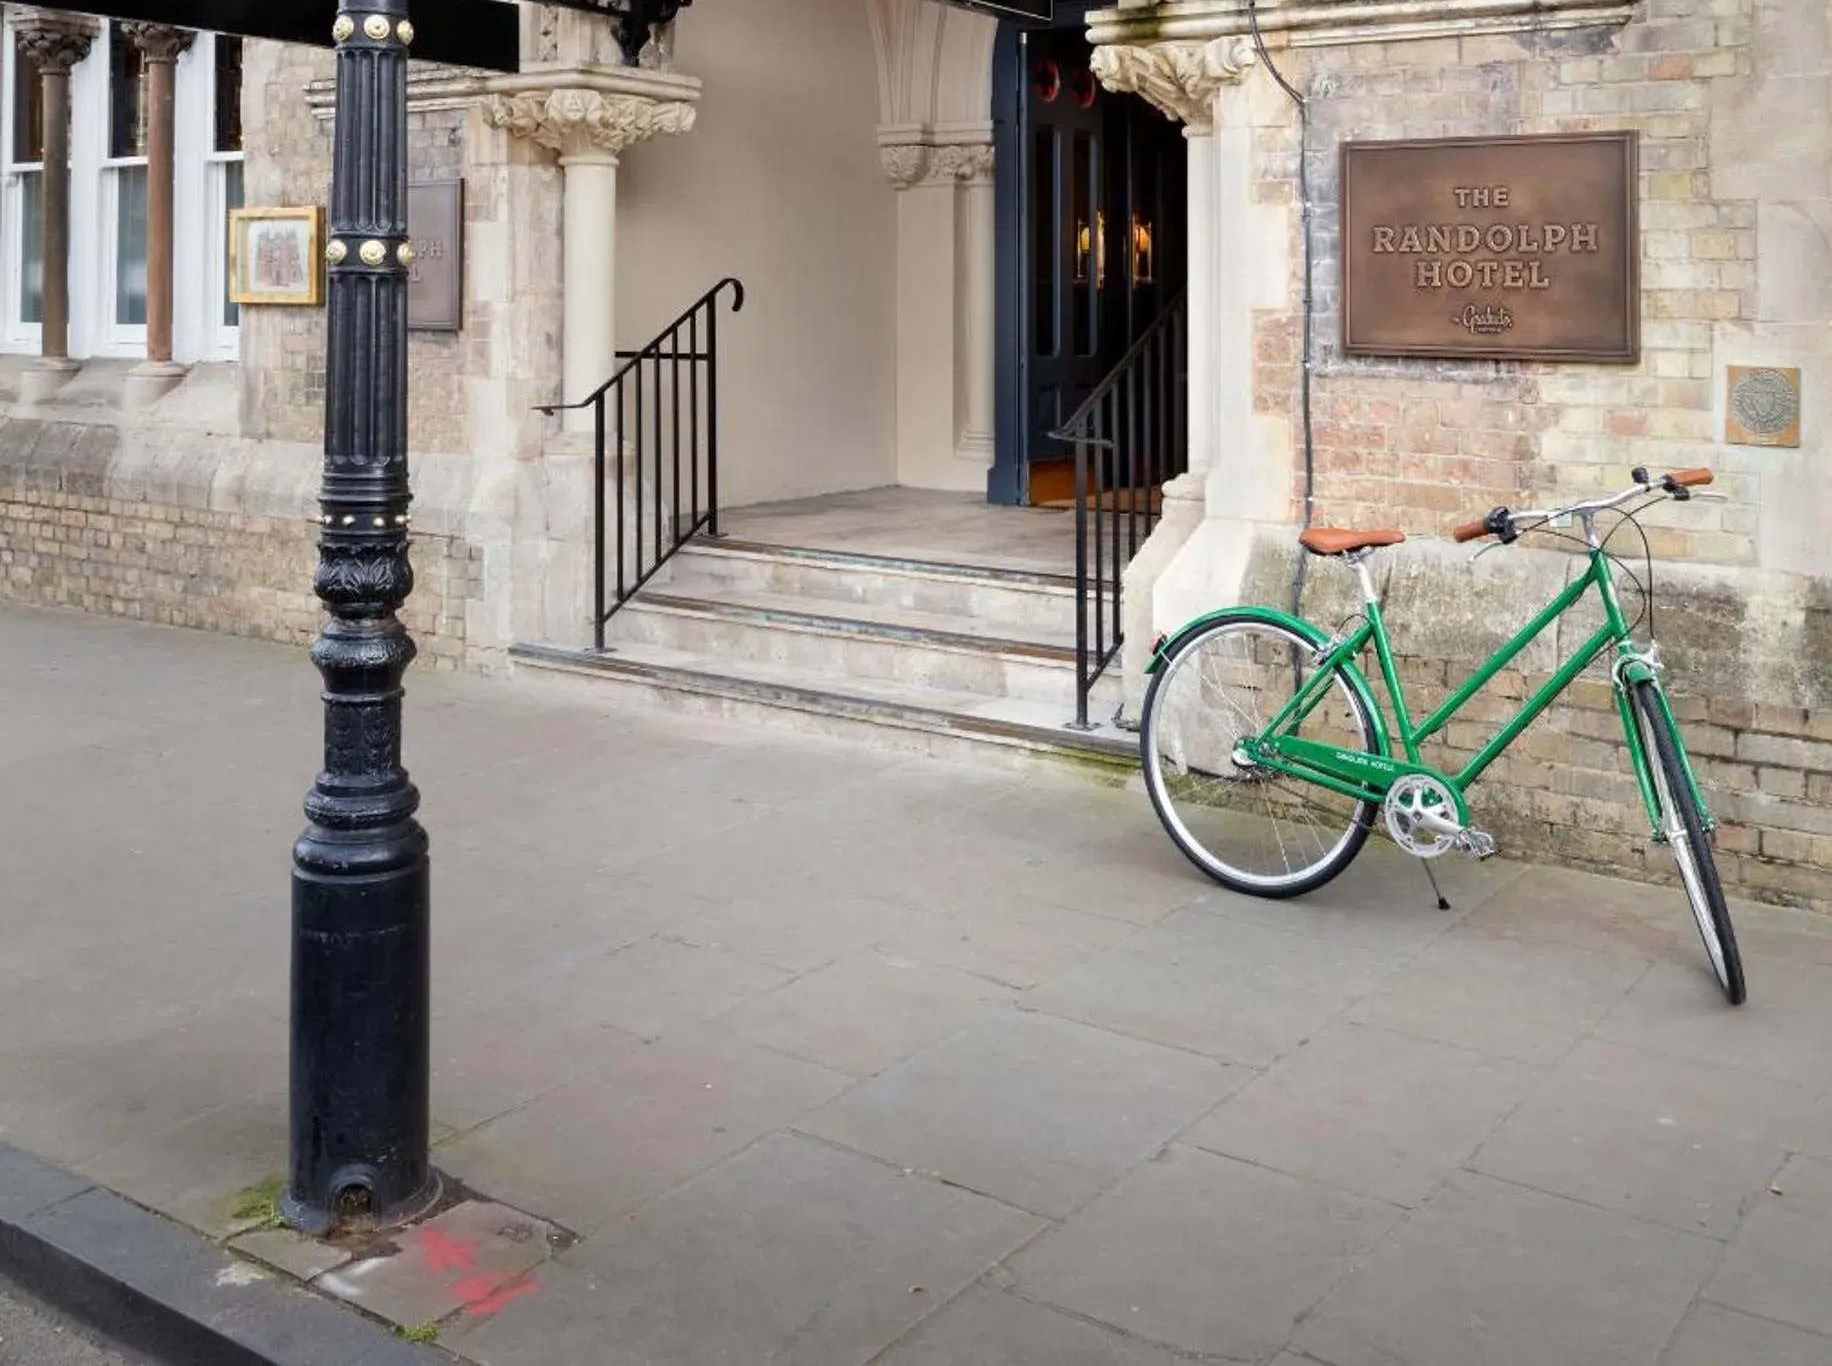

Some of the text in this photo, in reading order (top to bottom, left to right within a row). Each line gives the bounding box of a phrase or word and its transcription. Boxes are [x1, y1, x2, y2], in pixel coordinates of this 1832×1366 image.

[1454, 187, 1509, 208] THE
[1372, 223, 1599, 254] RANDOLPH
[1415, 260, 1551, 289] HOTEL
